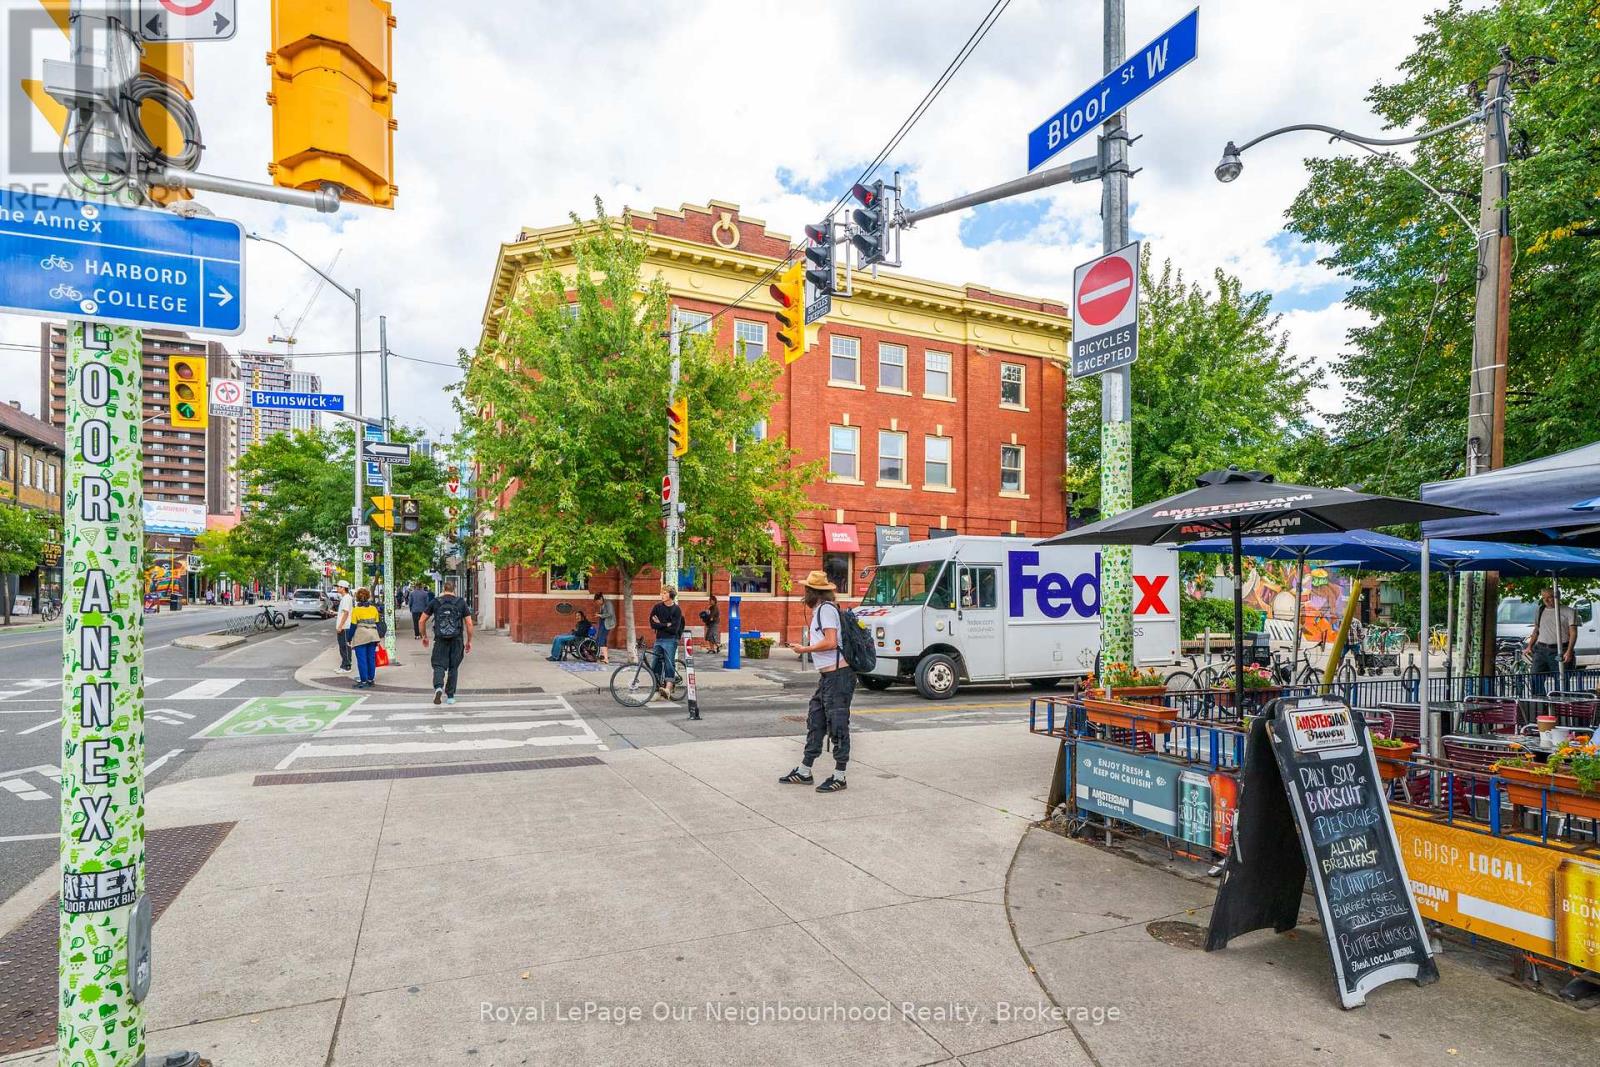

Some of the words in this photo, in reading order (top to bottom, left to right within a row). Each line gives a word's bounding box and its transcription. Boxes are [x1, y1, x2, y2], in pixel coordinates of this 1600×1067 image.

[1048, 87, 1110, 150] Bloor
[1121, 65, 1135, 85] St
[1146, 38, 1169, 79] W
[33, 213, 103, 233] Annex
[85, 259, 188, 286] HARBORD
[93, 288, 188, 313] COLLEGE
[807, 296, 829, 315] BICYCLES
[806, 305, 829, 323] EXCEPTED
[1078, 330, 1131, 357] BICYCLES
[1077, 346, 1132, 373] EXCEPTED
[256, 392, 327, 408] Brunswick
[332, 396, 341, 404] Av
[1152, 493, 1313, 518] AMSTERDAM
[1008, 551, 1170, 619] Fedx
[1295, 712, 1349, 730] AMSTERDAM
[1304, 729, 1345, 742] Brewery
[1093, 766, 1109, 777] KEEP
[1110, 772, 1120, 781] ON
[1098, 758, 1120, 771] ENJOY
[1122, 764, 1144, 777] FRESH
[1145, 770, 1151, 779] &
[1092, 788, 1130, 808] AMSTERDAM
[1314, 808, 1380, 839] PIEROGIES
[1331, 842, 1351, 857] ALL
[1349, 835, 1368, 853] DAY
[1322, 849, 1379, 875] BREAKFAST
[1414, 838, 1463, 868] CRISP.
[1469, 852, 1532, 888] LOCAL.
[1330, 870, 1393, 900] SCHNITZEL
[87, 896, 120, 911] ANNEX
[121, 891, 136, 904] BIA
[1332, 897, 1367, 919] BURGER
[1371, 891, 1397, 908] FRIES
[1339, 932, 1384, 960] BUTTER
